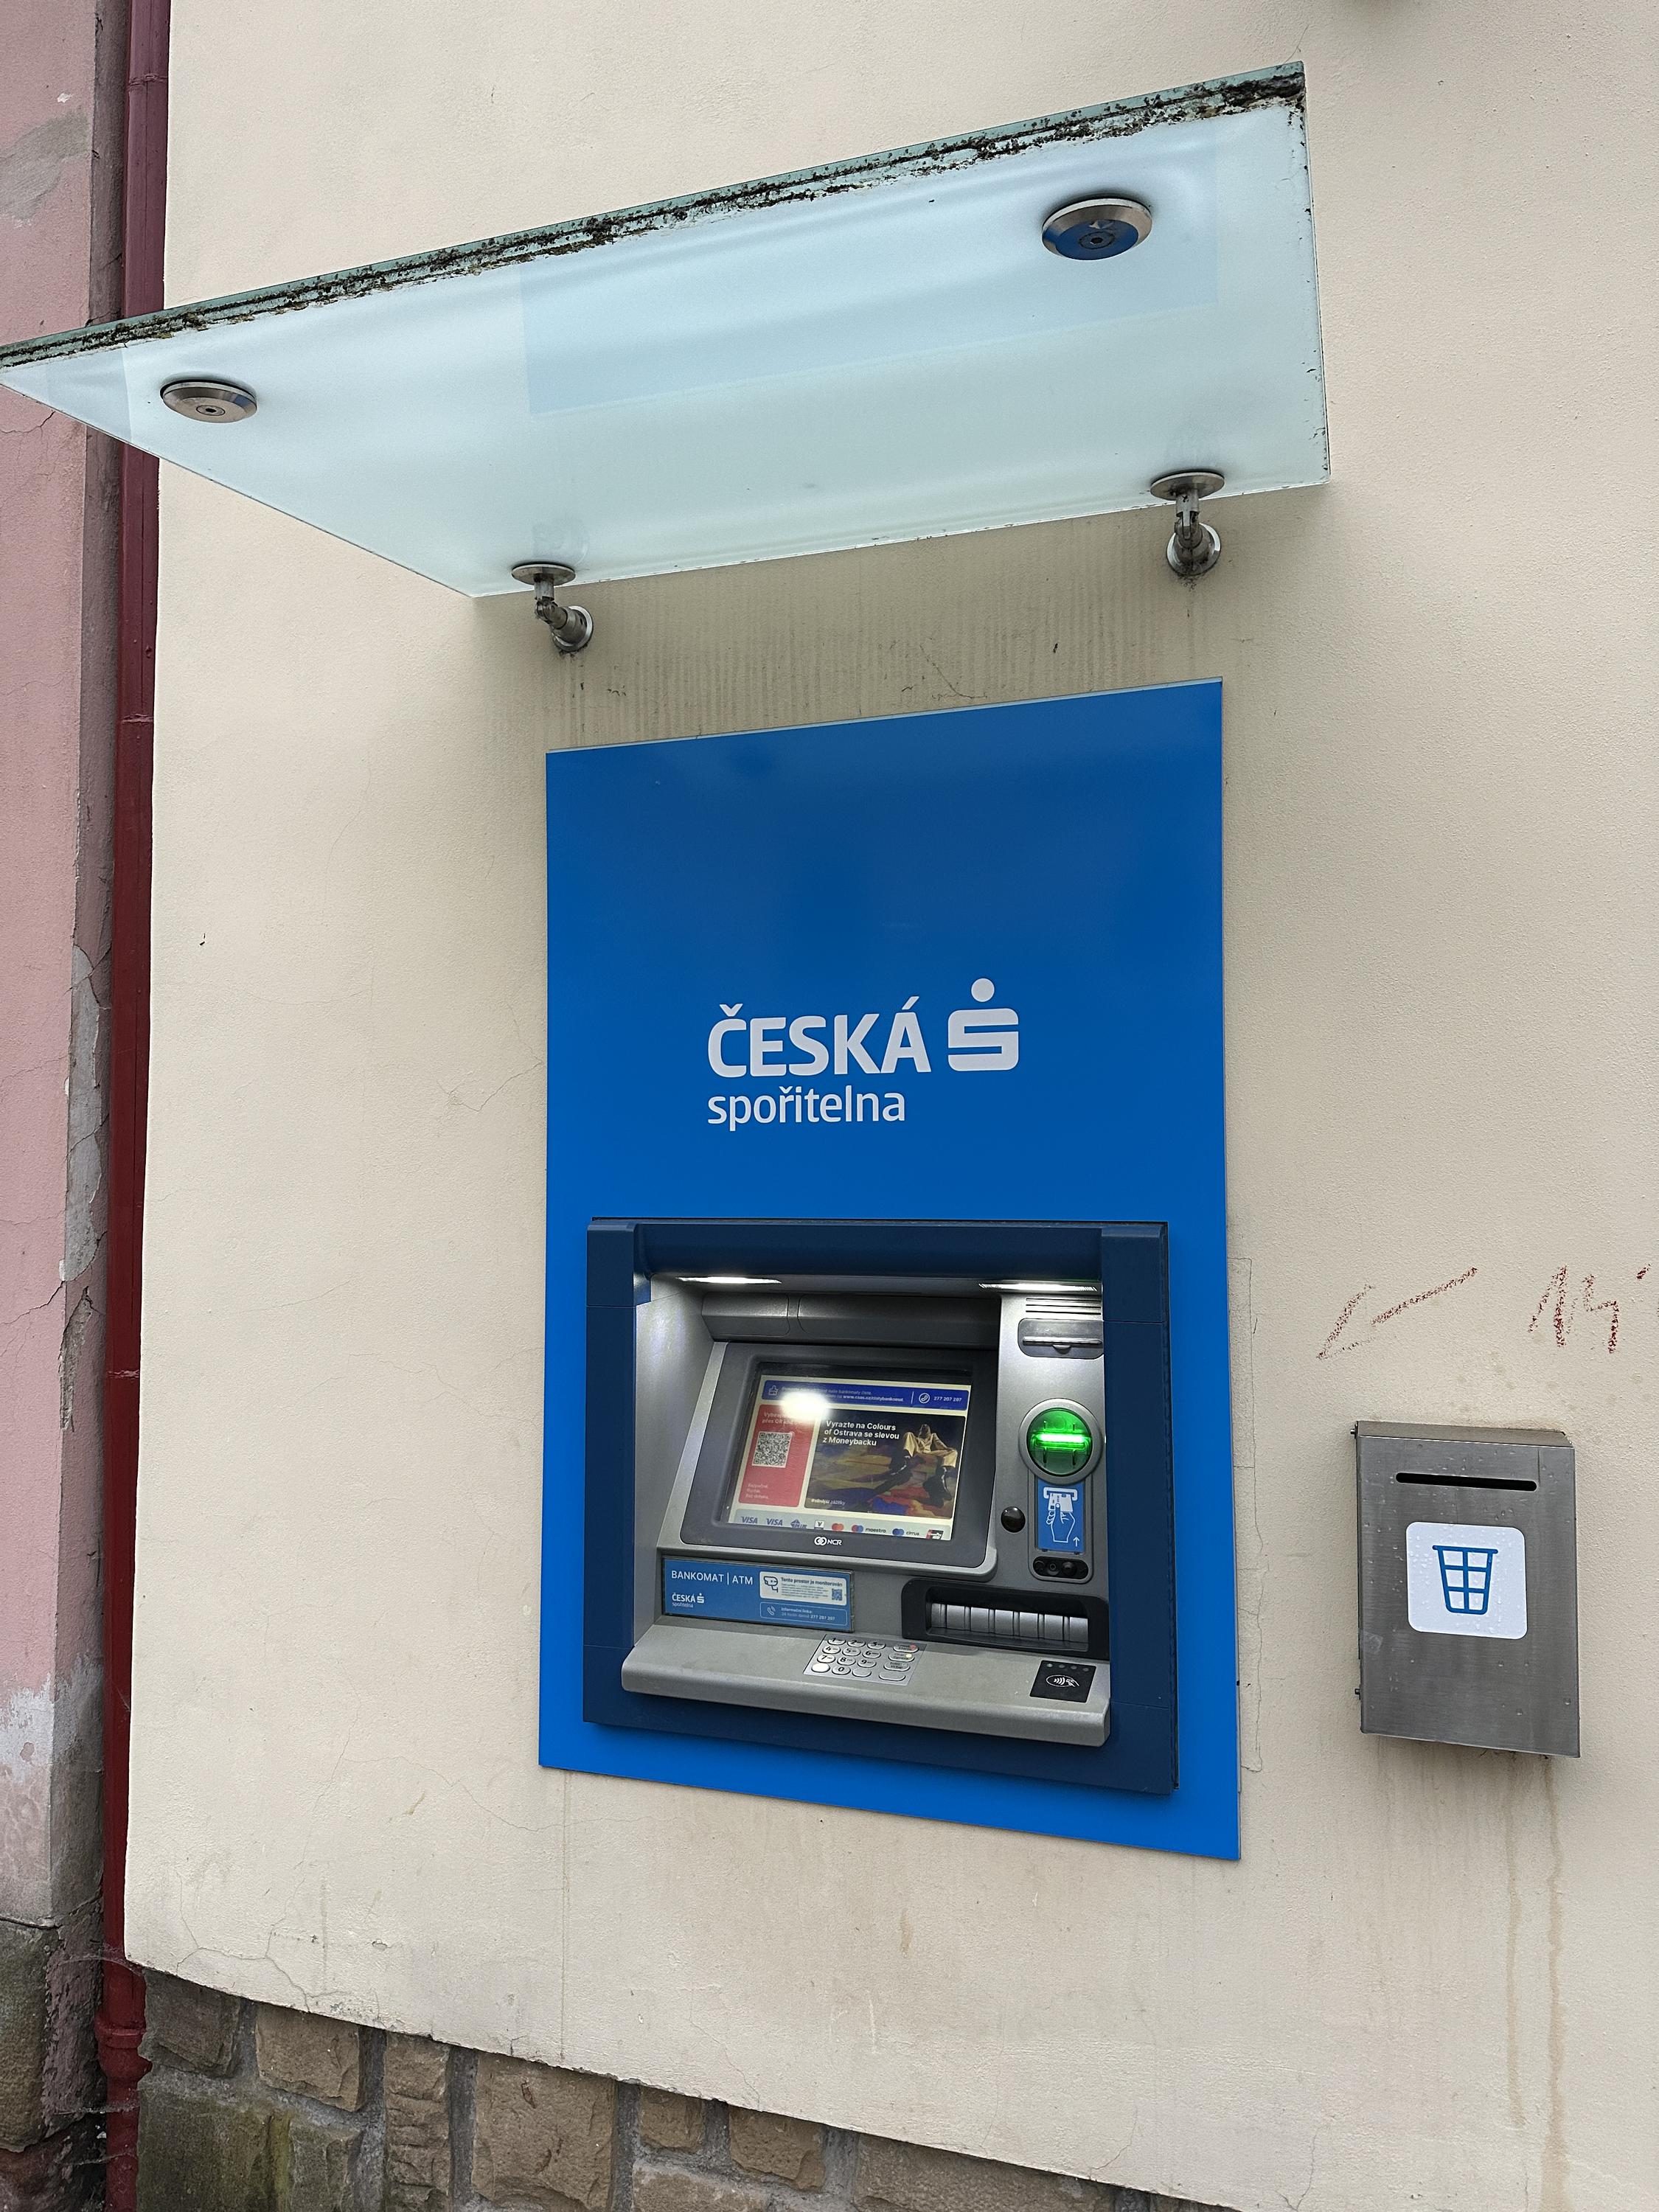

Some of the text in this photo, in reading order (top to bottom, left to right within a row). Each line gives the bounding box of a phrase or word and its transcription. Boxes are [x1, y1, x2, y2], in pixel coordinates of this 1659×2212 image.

[708, 996, 931, 1078] ČESKÁ
[708, 1085, 905, 1131] spořitelna
[826, 1420, 855, 1429] Vyrazte
[866, 1422, 896, 1431] Colours
[833, 1429, 863, 1438] Ostrava
[874, 1431, 900, 1439] slevou
[828, 1436, 877, 1447] Moneybacku
[741, 1516, 758, 1524] VISA
[766, 1517, 783, 1526] VISA
[671, 1570, 753, 1585] BANKOMAT ATM
[672, 1593, 695, 1603] ČESKÁ
